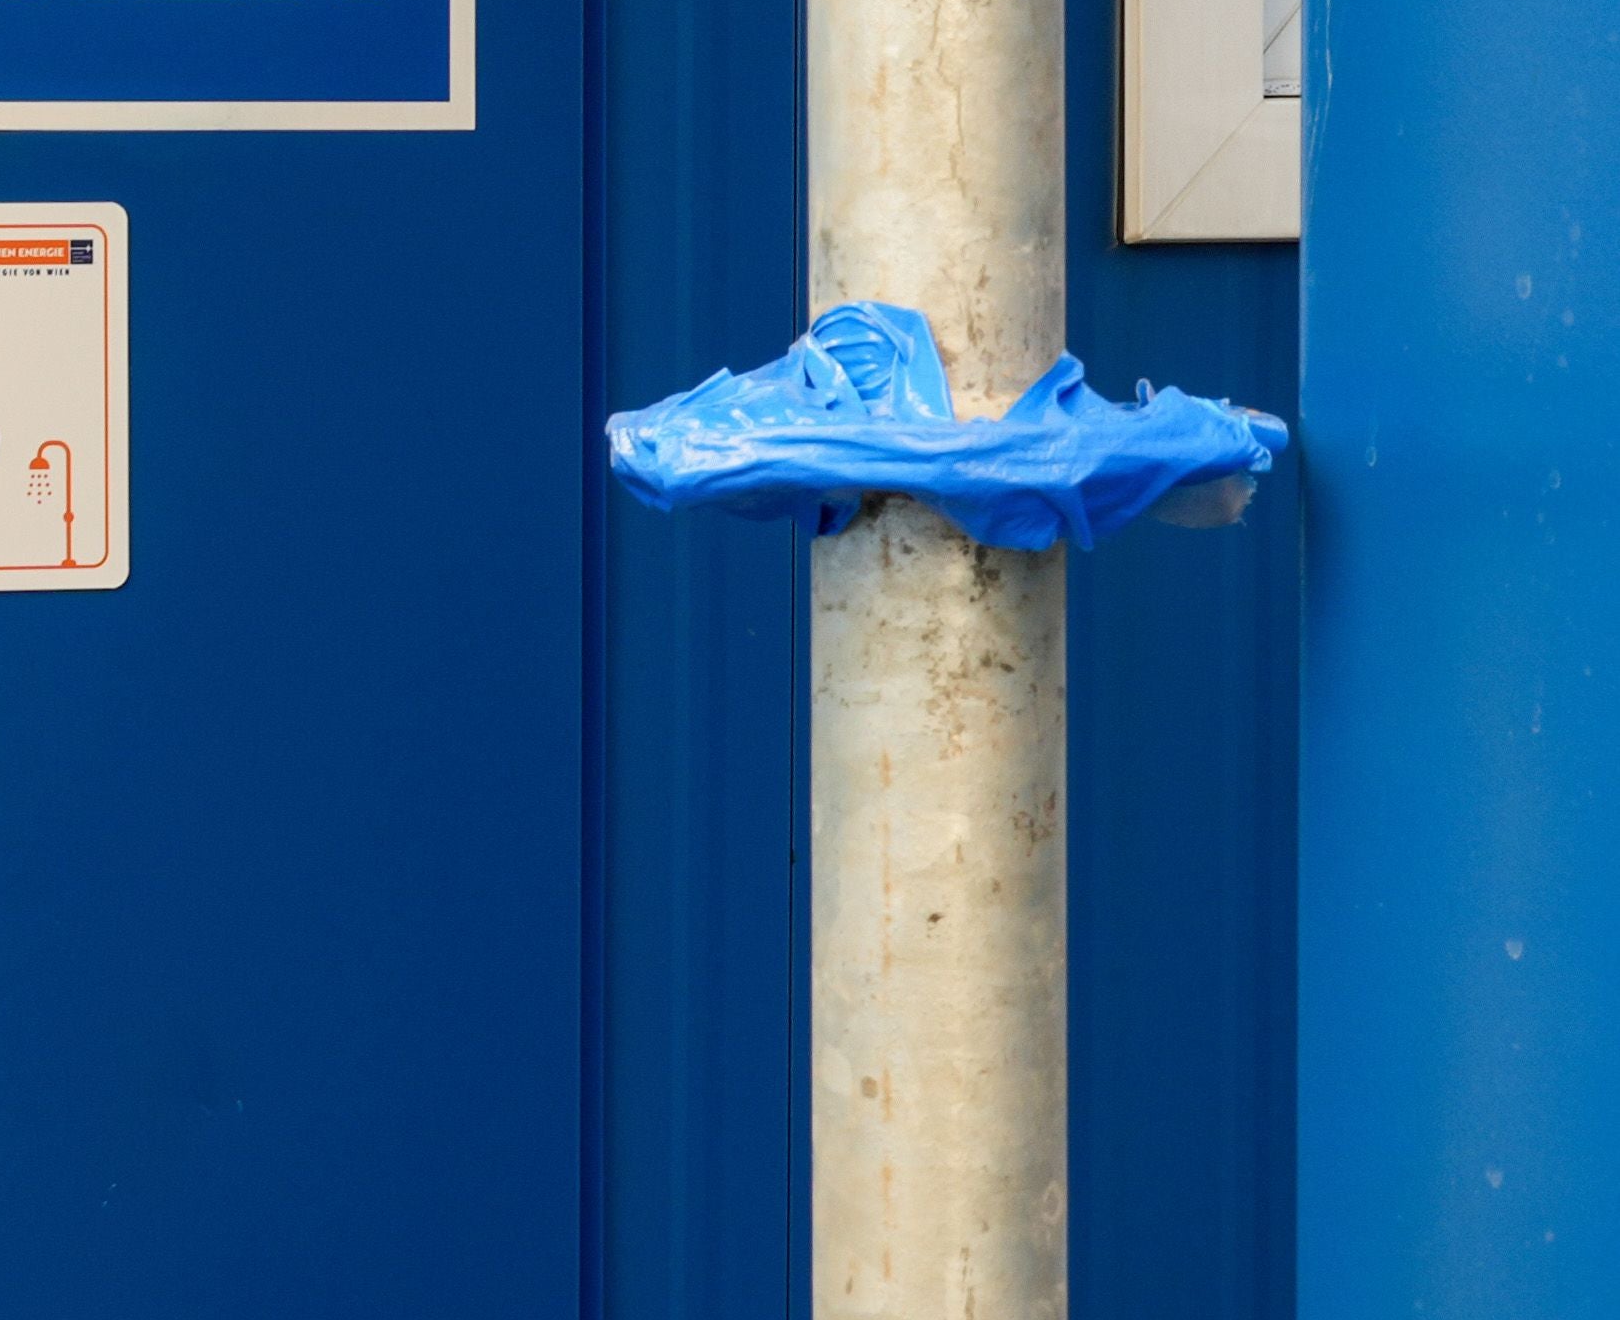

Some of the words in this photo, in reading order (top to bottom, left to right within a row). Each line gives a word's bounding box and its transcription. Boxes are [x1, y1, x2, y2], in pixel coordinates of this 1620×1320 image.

[18, 246, 65, 258] ENERGIE
[23, 268, 41, 276] VON
[46, 268, 70, 276] WIEN
